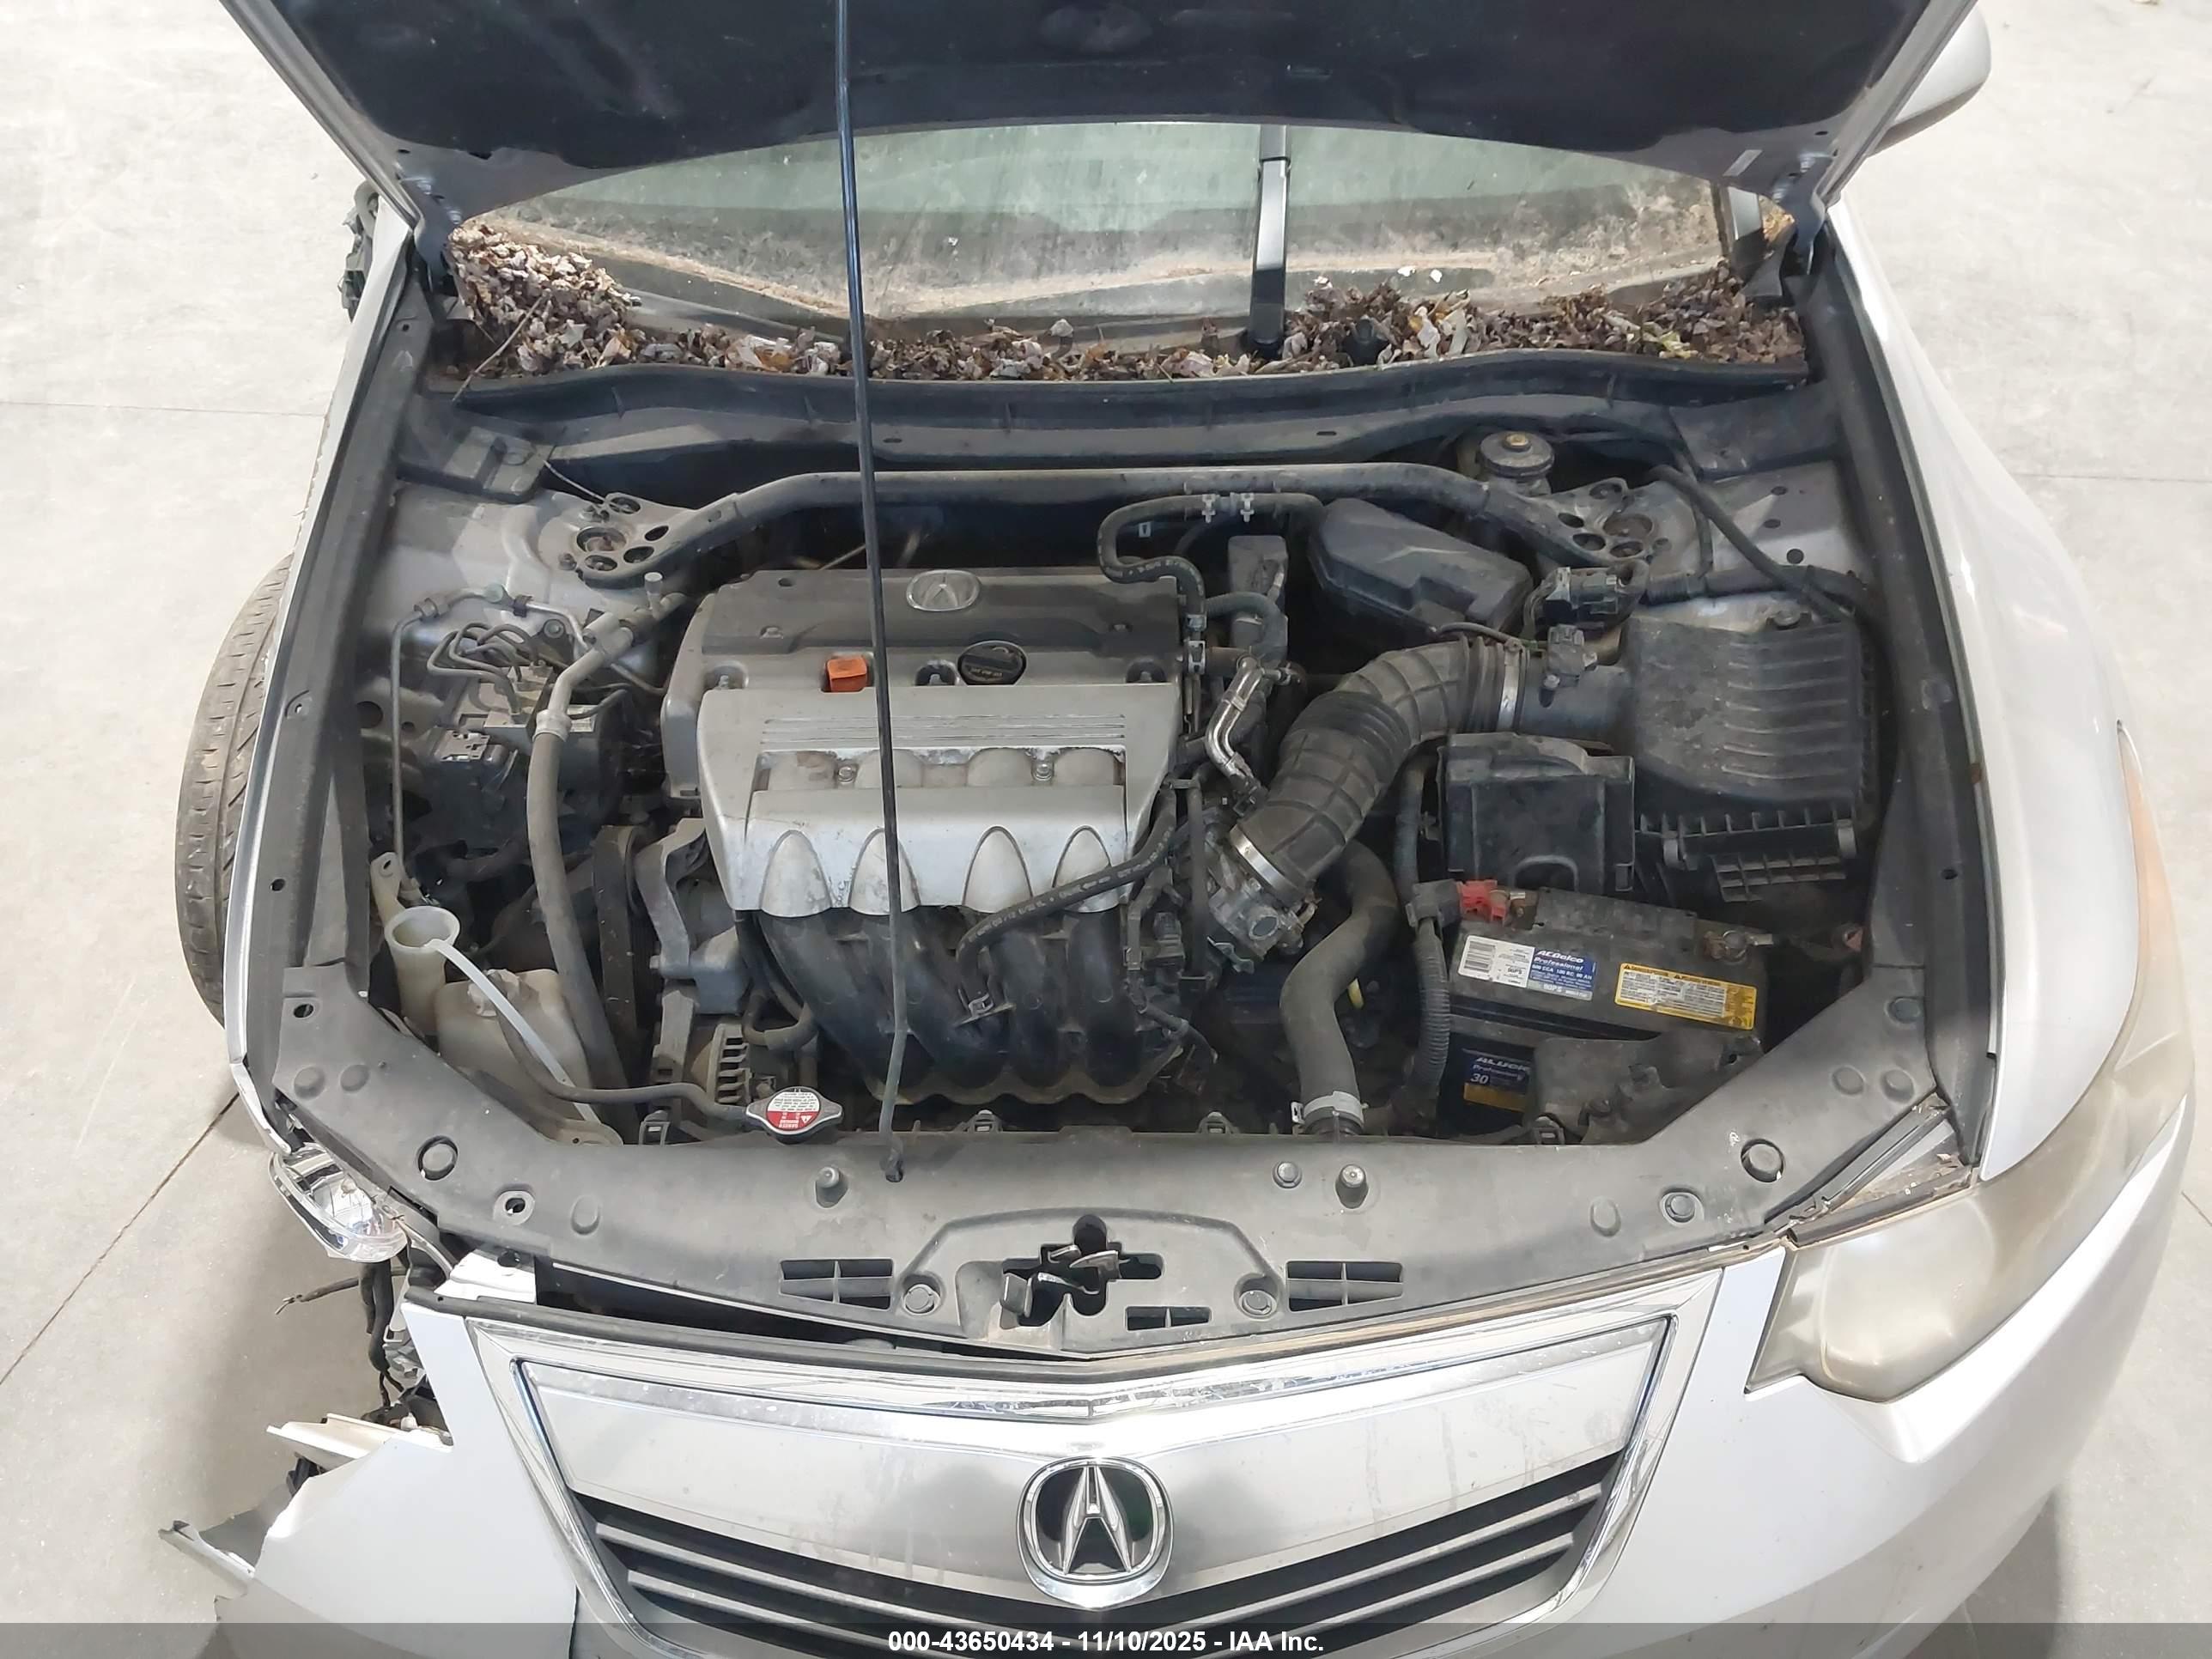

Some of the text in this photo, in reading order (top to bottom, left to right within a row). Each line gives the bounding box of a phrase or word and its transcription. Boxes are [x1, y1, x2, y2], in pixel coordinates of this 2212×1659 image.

[1536, 950, 1584, 963] ACDelco
[1534, 957, 1583, 970] Professional
[1470, 1073, 1489, 1085] 30
